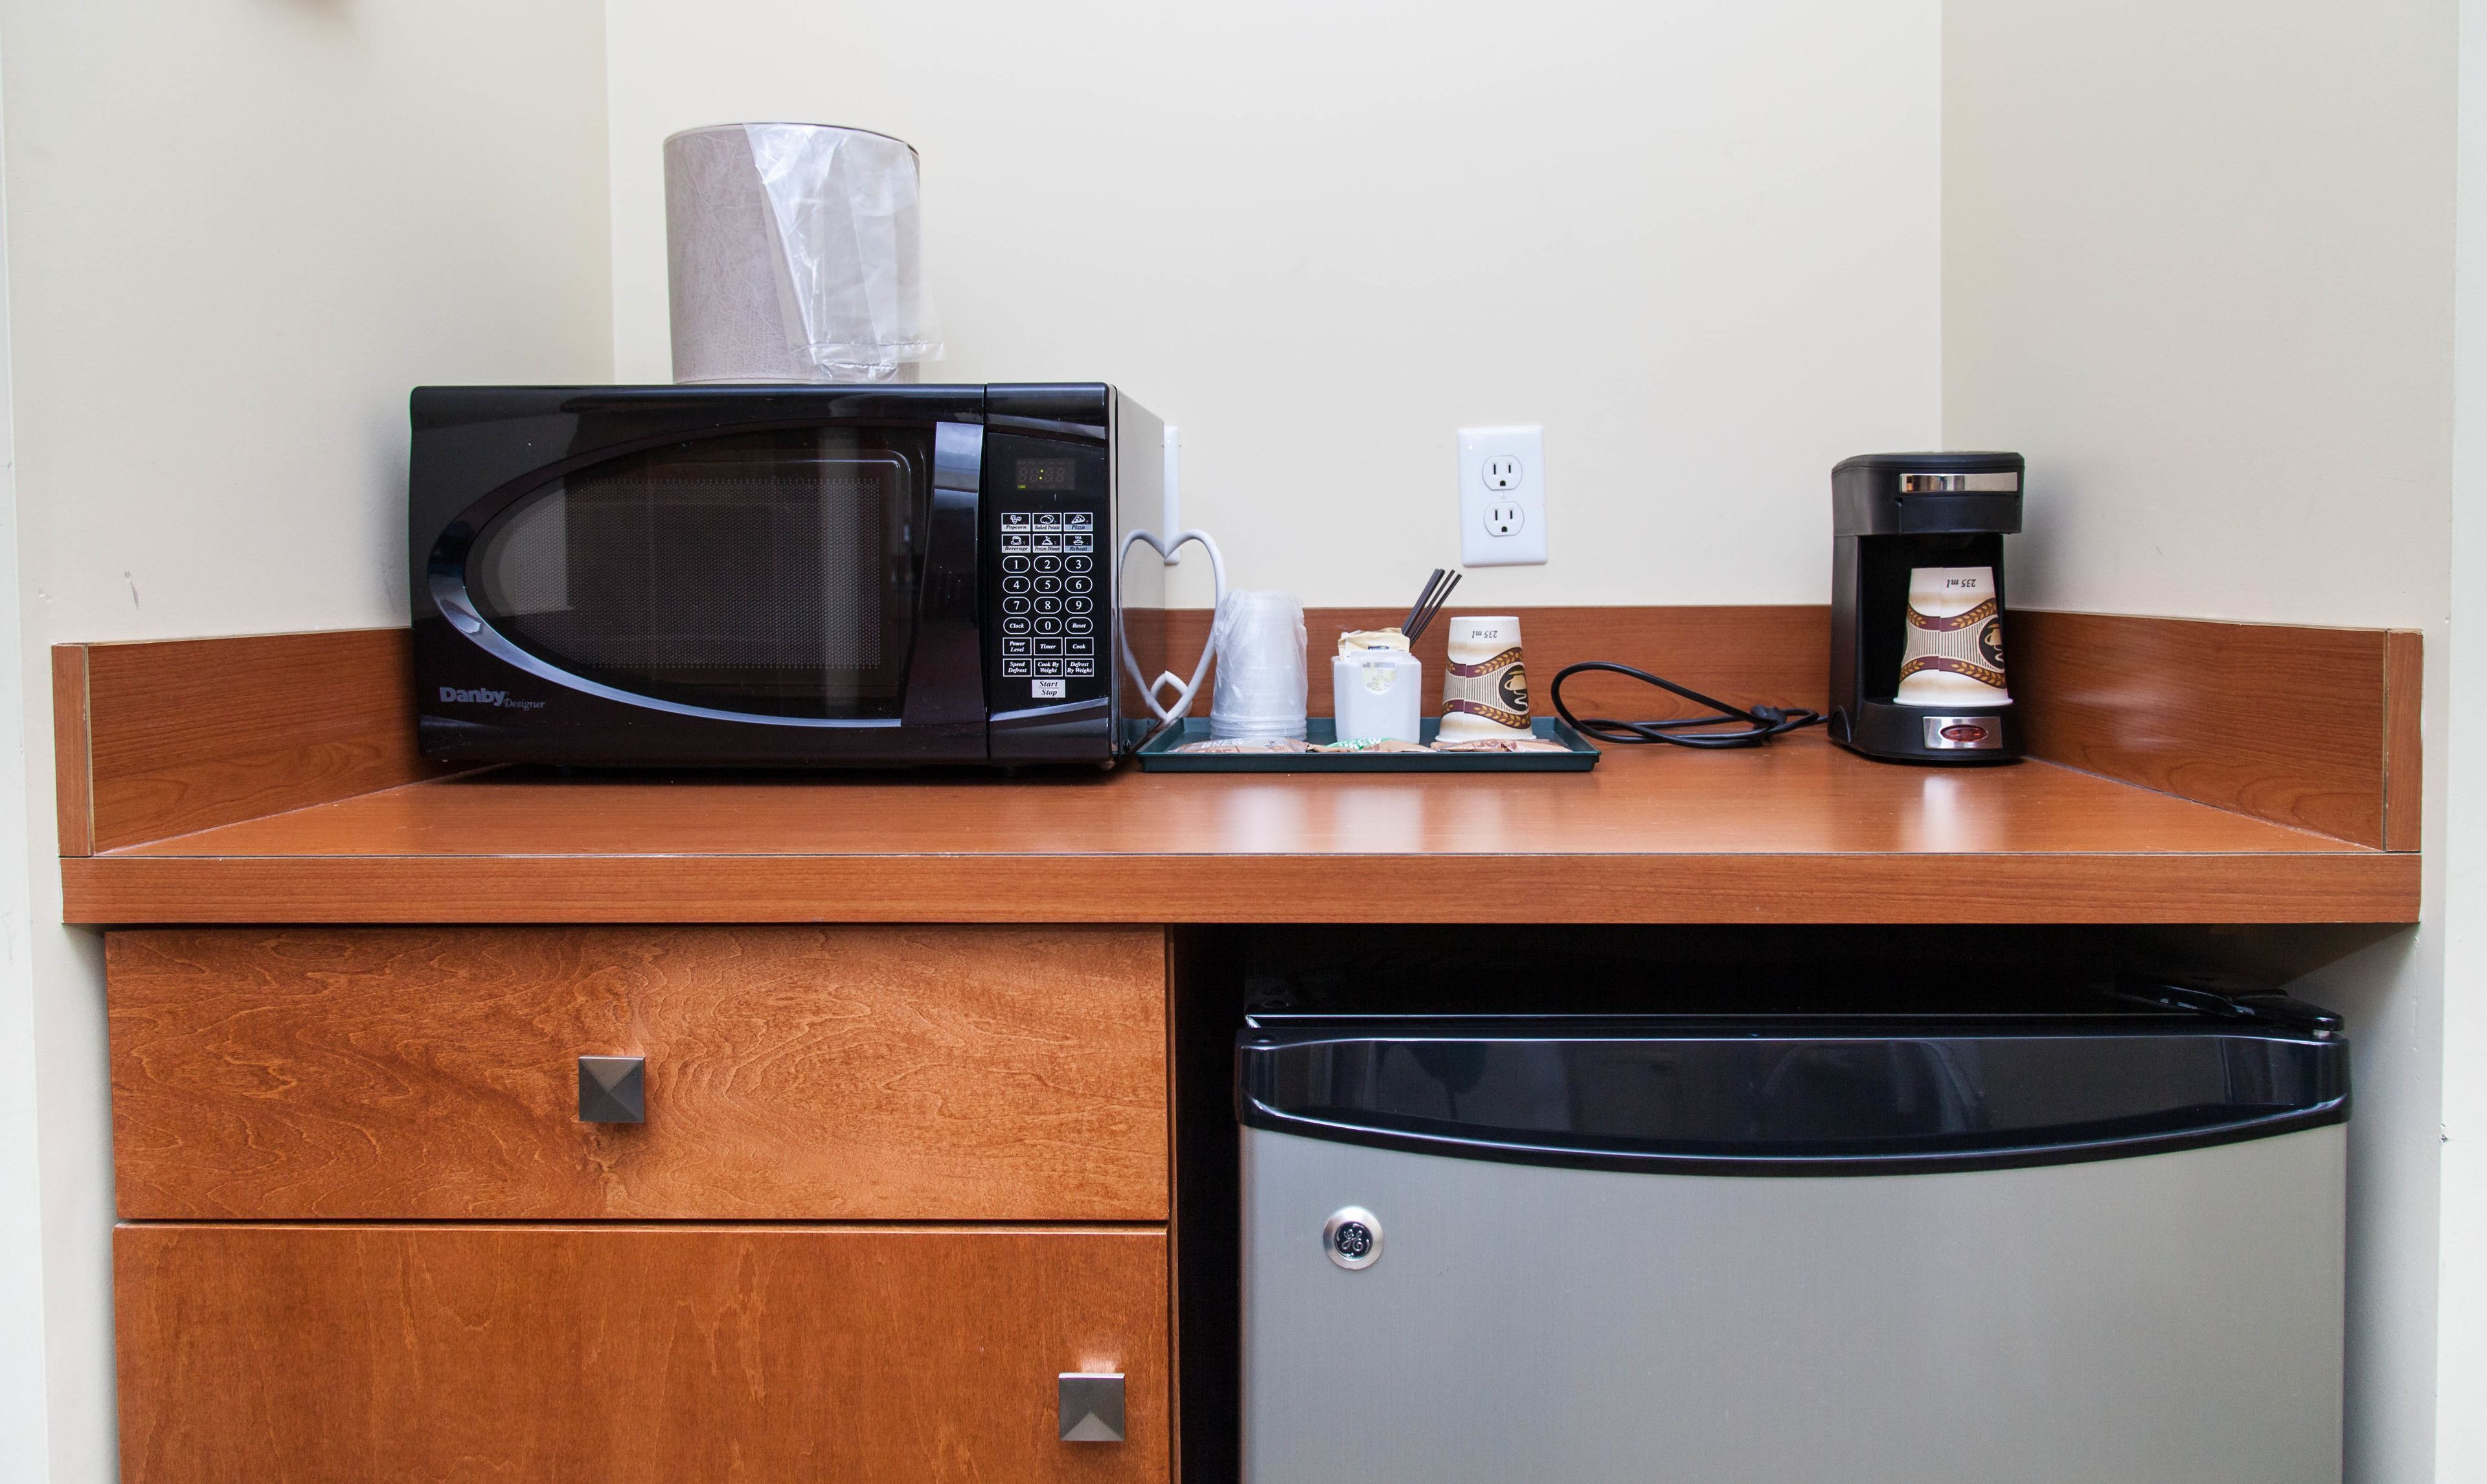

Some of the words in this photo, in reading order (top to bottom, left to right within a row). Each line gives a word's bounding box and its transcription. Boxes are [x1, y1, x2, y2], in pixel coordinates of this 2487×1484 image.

[1014, 560, 1018, 569] 1
[1044, 560, 1050, 569] 2
[1075, 560, 1082, 569] 3
[1013, 580, 1020, 589] 4
[1045, 580, 1050, 589] 5
[1075, 580, 1082, 589] 6
[1961, 579, 1976, 587] 235
[1014, 601, 1020, 610] 7
[1045, 601, 1050, 610] 8
[1075, 601, 1082, 610] 9
[1045, 621, 1051, 631] 0
[439, 687, 506, 707] Danby
[504, 698, 546, 710] Designer
